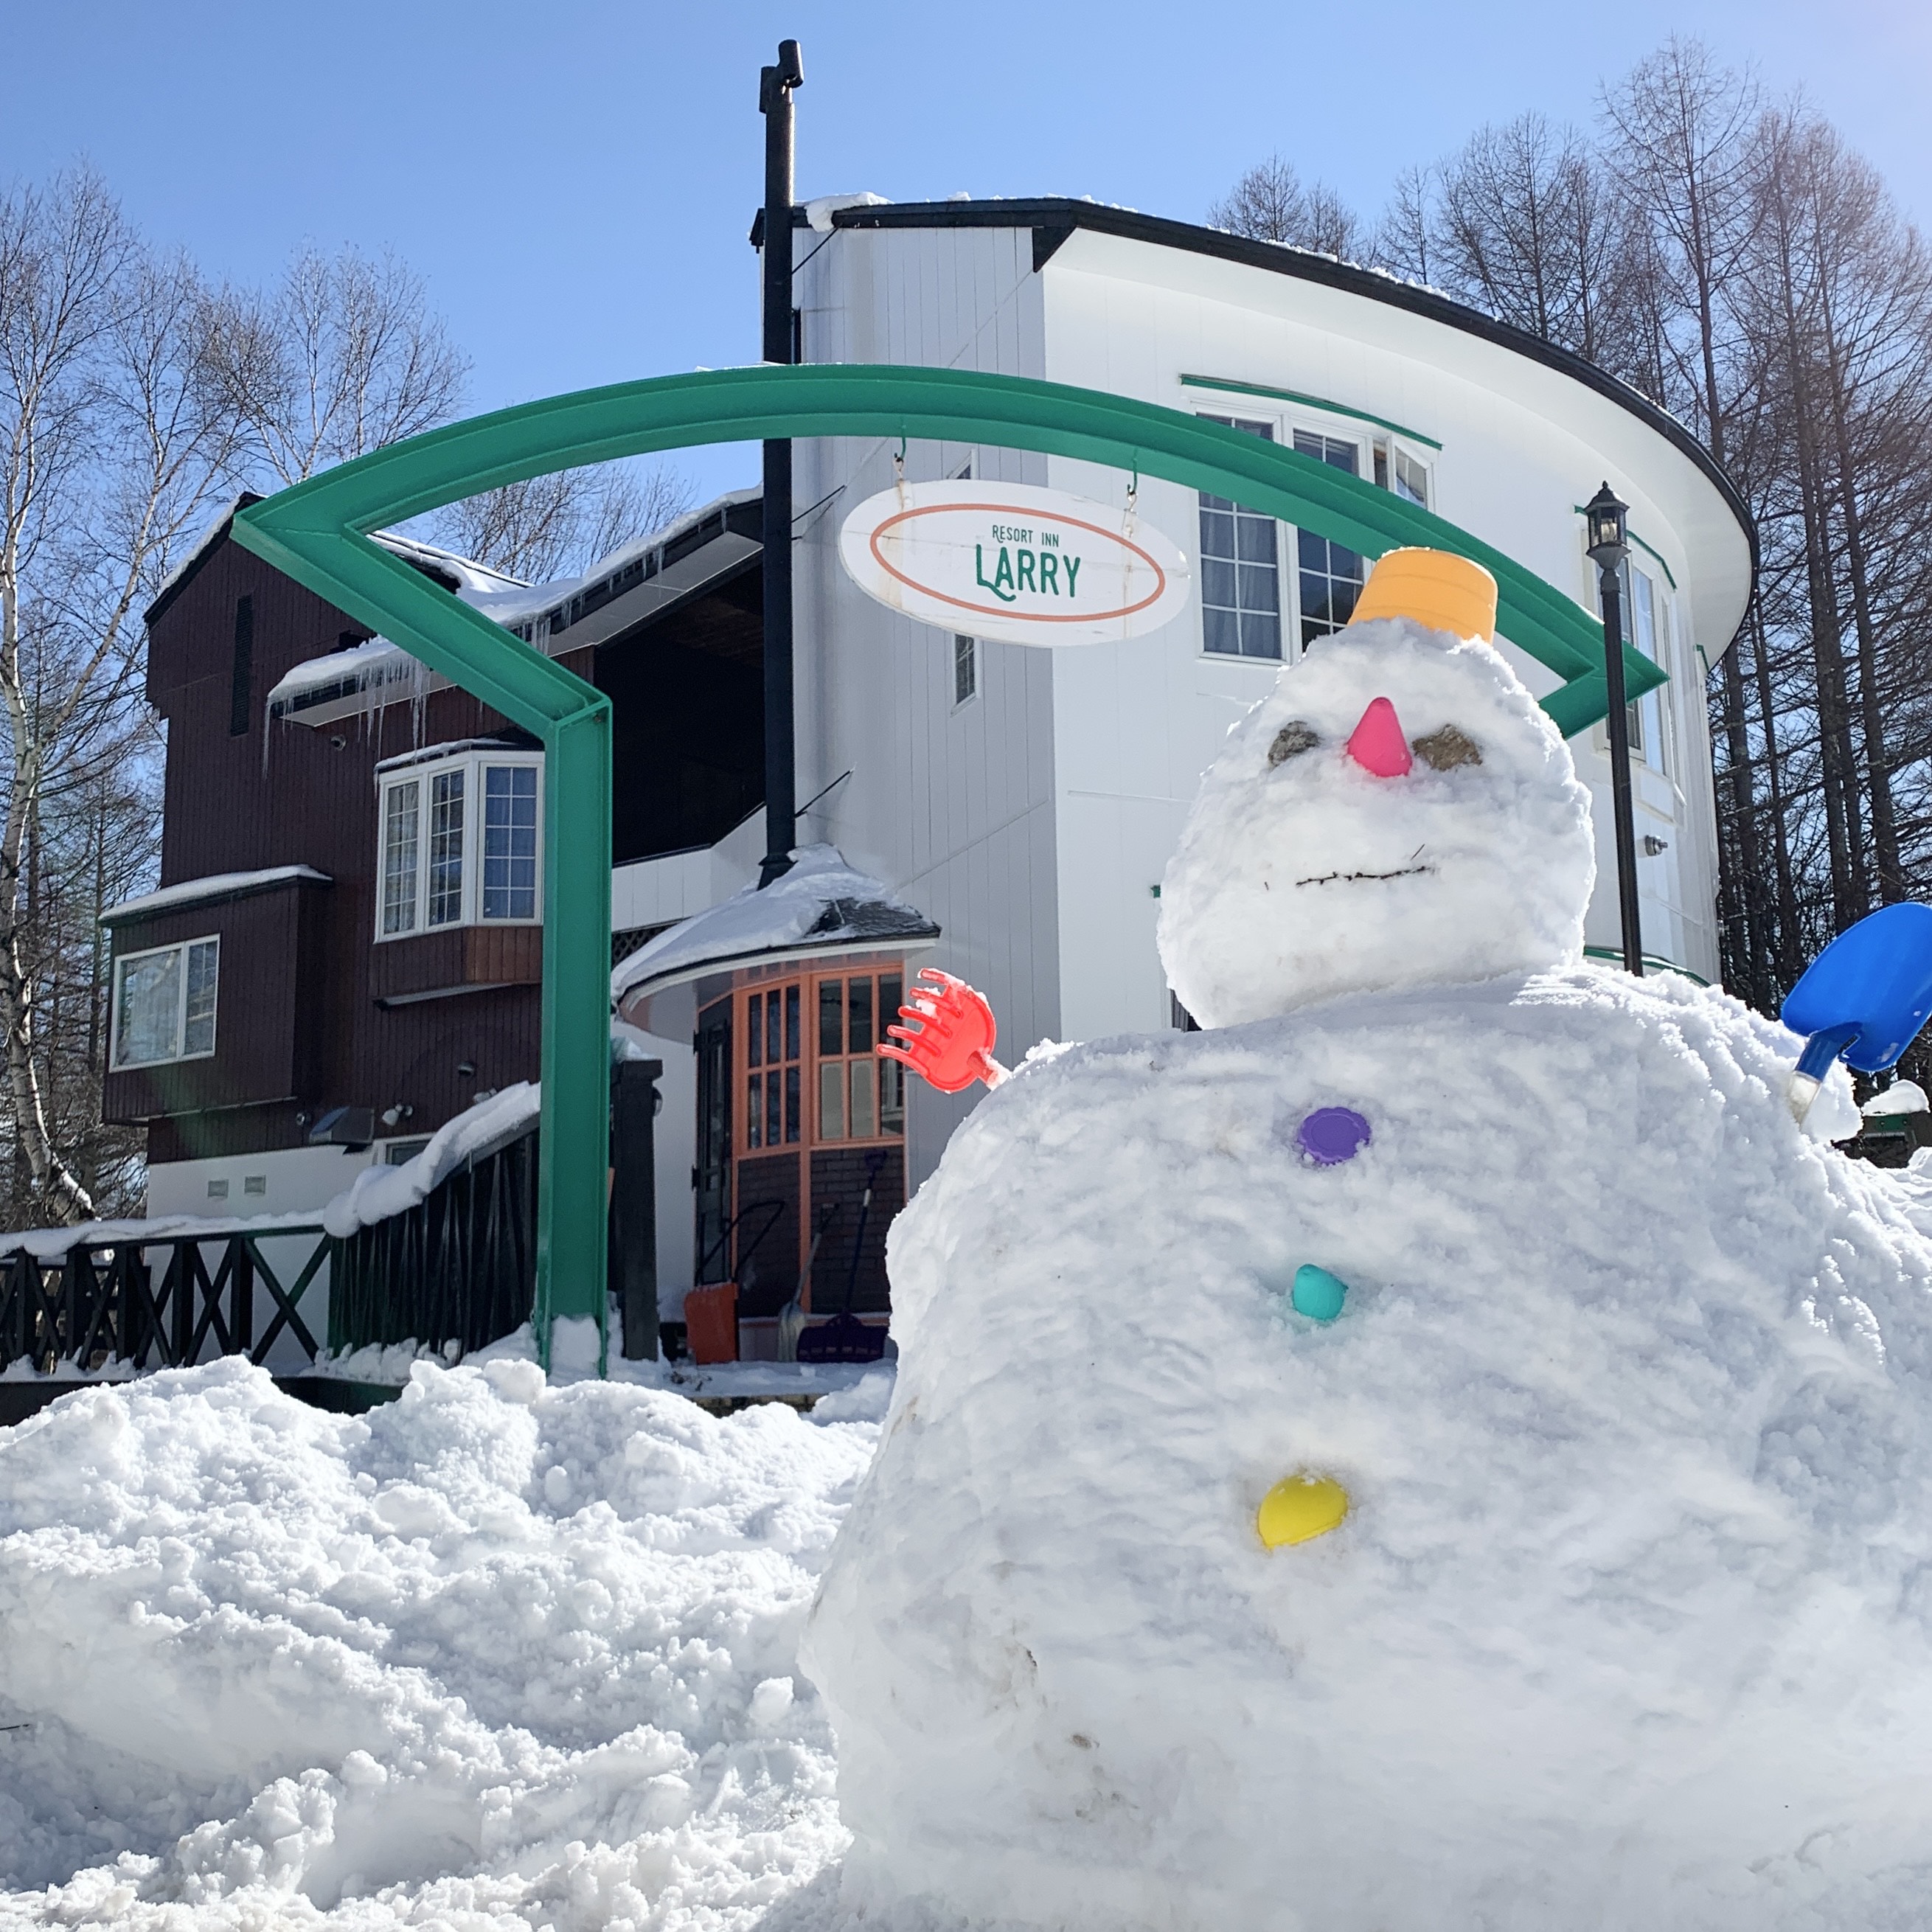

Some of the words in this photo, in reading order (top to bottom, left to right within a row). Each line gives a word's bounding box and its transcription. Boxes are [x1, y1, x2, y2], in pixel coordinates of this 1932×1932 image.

[993, 525, 1033, 543] RESORT
[1041, 532, 1059, 547] INN
[976, 543, 1081, 602] LARRY
